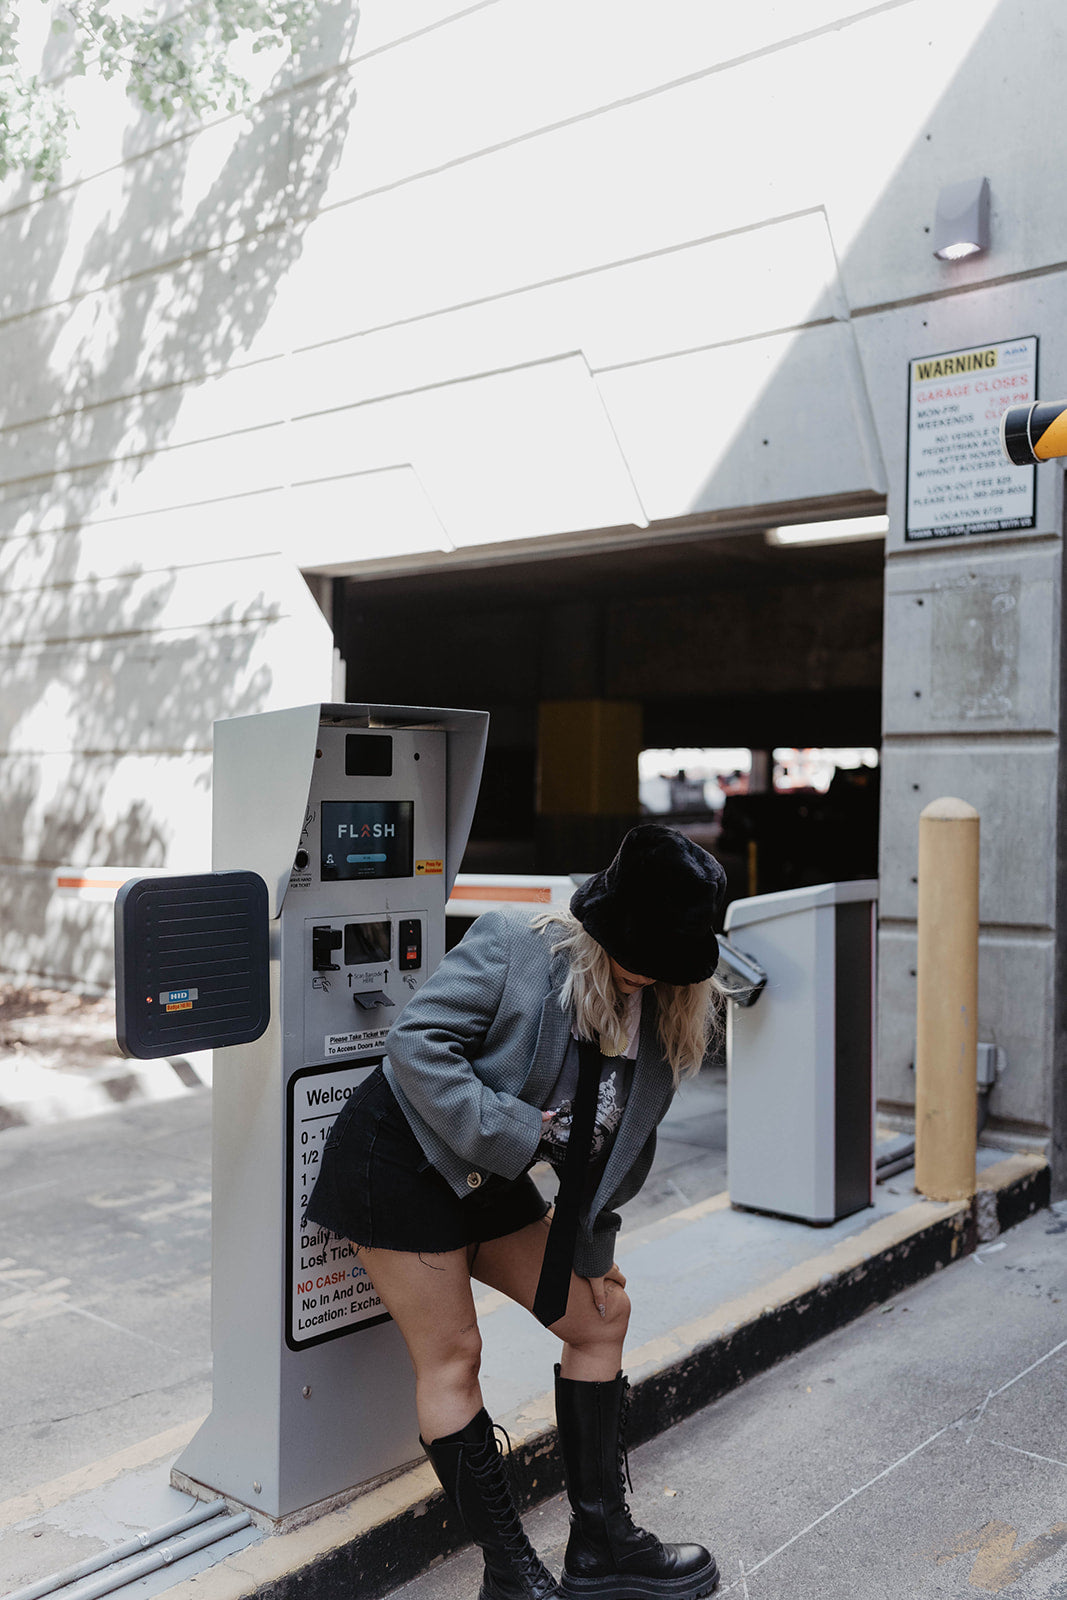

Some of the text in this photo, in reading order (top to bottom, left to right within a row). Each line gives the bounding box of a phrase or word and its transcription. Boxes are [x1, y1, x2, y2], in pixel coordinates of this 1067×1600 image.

[918, 350, 996, 380] WARNING
[917, 375, 1028, 404] GARAGE CLOSES
[917, 413, 974, 430] WEEKENDS
[952, 429, 988, 441] VEHICLE
[922, 441, 979, 456] PEDESTRIAN
[938, 454, 968, 464] AFTER
[916, 465, 956, 478] WITHOUT
[959, 460, 996, 473] ACCESS
[913, 495, 946, 506] PLEASE
[948, 491, 970, 501] CALL
[934, 509, 981, 522] LOCATION
[338, 822, 395, 839] FLASH
[170, 992, 187, 1000] HID
[330, 1035, 348, 1043] Please
[350, 1033, 362, 1041] Take
[363, 1031, 379, 1039] Ticket
[328, 1046, 336, 1054] To
[337, 1044, 357, 1053] Access
[301, 1150, 319, 1166] 1/2
[301, 1173, 307, 1186] 1
[300, 1194, 308, 1208] 2
[301, 1231, 330, 1249] Daily
[301, 1252, 327, 1270] Lost
[297, 1280, 313, 1295] NO
[302, 1298, 317, 1311] No
[320, 1294, 329, 1306] In
[333, 1285, 354, 1302] And
[298, 1306, 348, 1331] Location:
